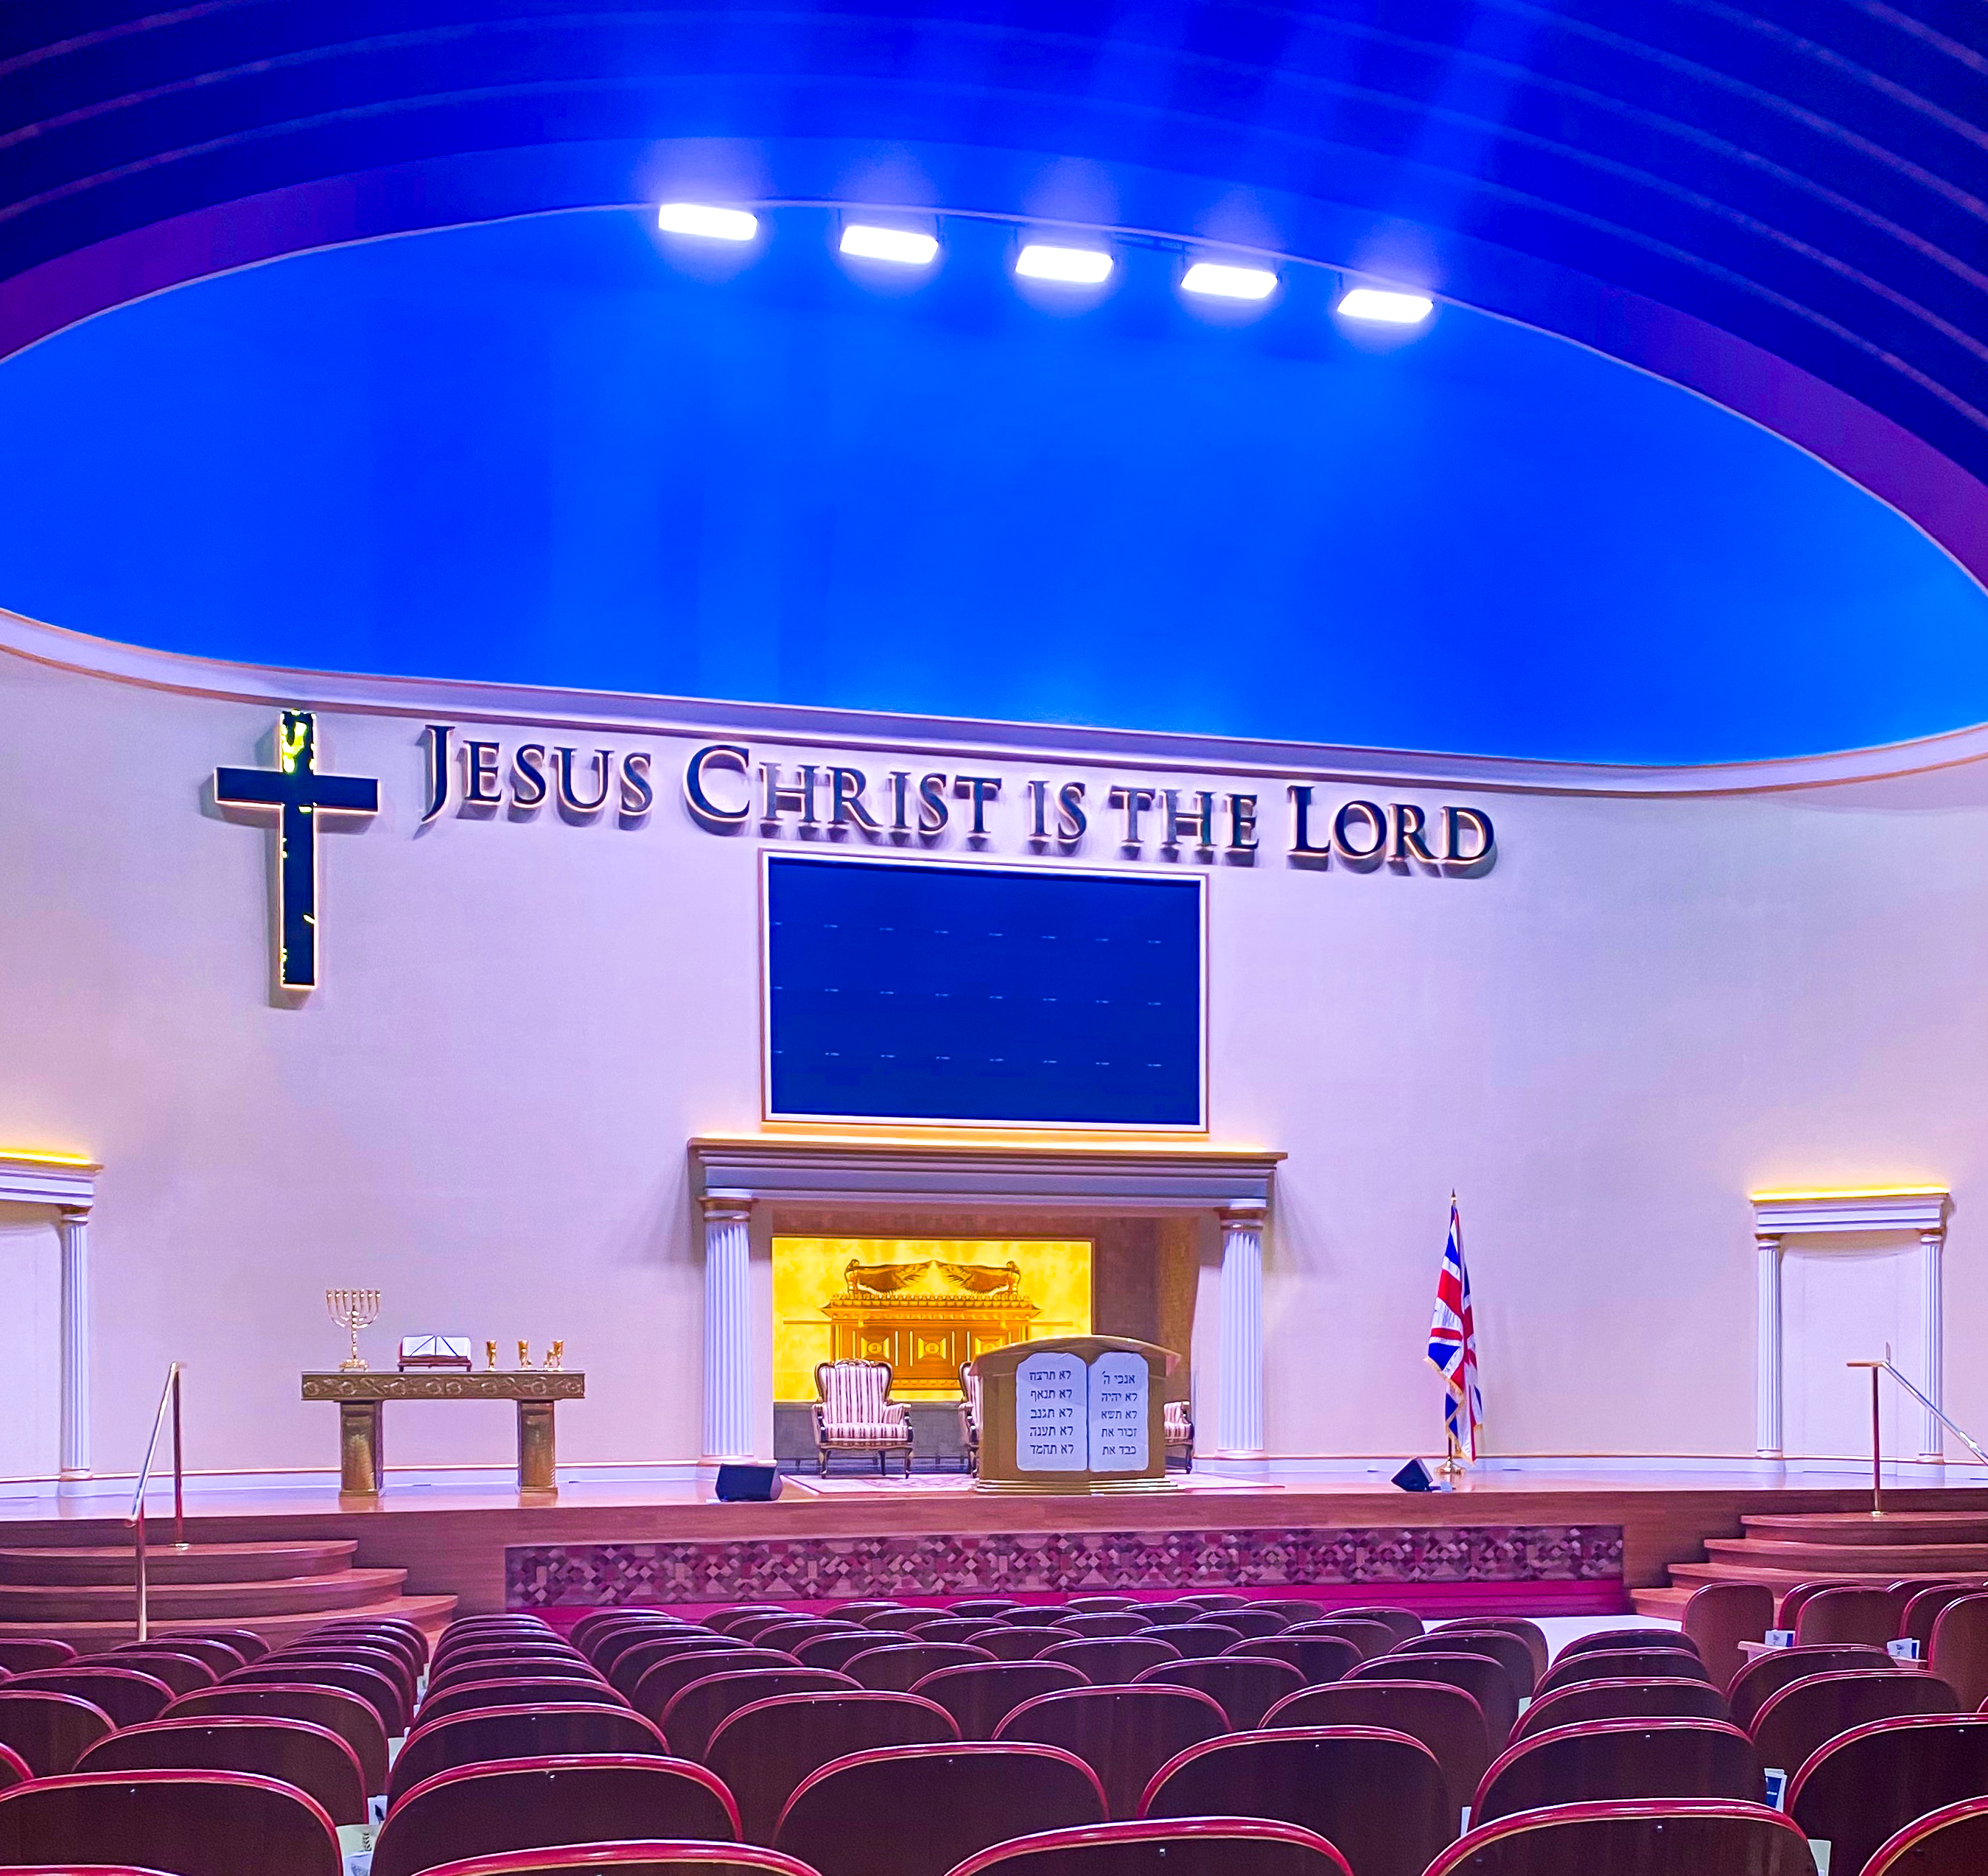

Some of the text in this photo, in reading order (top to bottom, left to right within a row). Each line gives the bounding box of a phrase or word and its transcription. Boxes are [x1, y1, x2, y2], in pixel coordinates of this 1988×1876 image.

[421, 725, 1495, 864] JESUS CHRIST IS THE LORD
[1059, 1370, 1071, 1380] לא
[1113, 1374, 1135, 1385] אנכי
[1030, 1389, 1073, 1402] לא תנאף
[1101, 1392, 1138, 1402] לא יהיה
[1030, 1407, 1073, 1419] לא תגנב
[1101, 1410, 1138, 1419] לא תשא
[1029, 1426, 1074, 1437] לא תענה
[1101, 1428, 1138, 1438] זכור את
[1060, 1443, 1074, 1455] לא
[1102, 1446, 1136, 1455] כבד את
